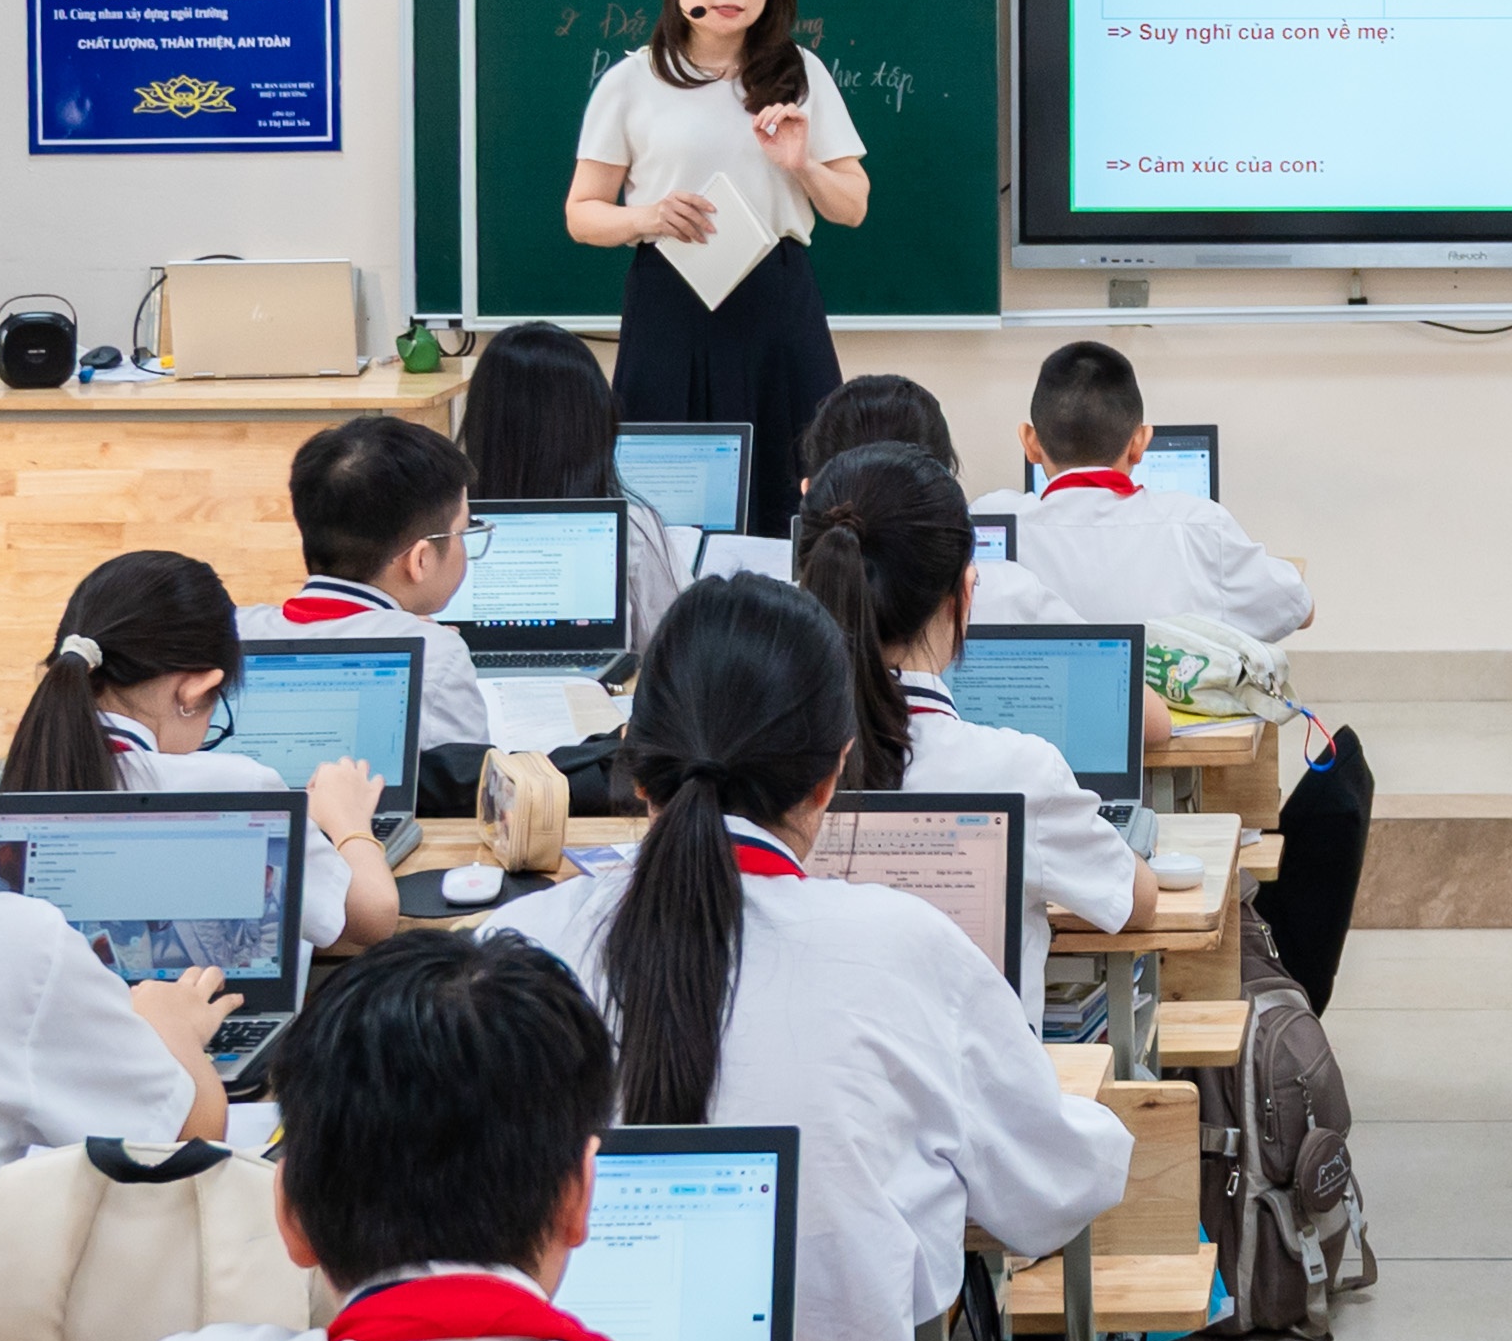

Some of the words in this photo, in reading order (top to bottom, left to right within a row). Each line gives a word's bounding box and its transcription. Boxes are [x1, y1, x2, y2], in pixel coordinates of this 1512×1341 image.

[1140, 24, 1178, 44] Suy
[1187, 24, 1232, 44] nghĩ
[1239, 23, 1274, 39] của
[1283, 28, 1319, 39] con
[1327, 20, 1350, 39] về
[1359, 28, 1394, 43] mẹ:
[1139, 156, 1184, 172] Cảm
[1192, 156, 1228, 172] xúc
[1236, 156, 1272, 172] của
[1280, 161, 1323, 172] con:
